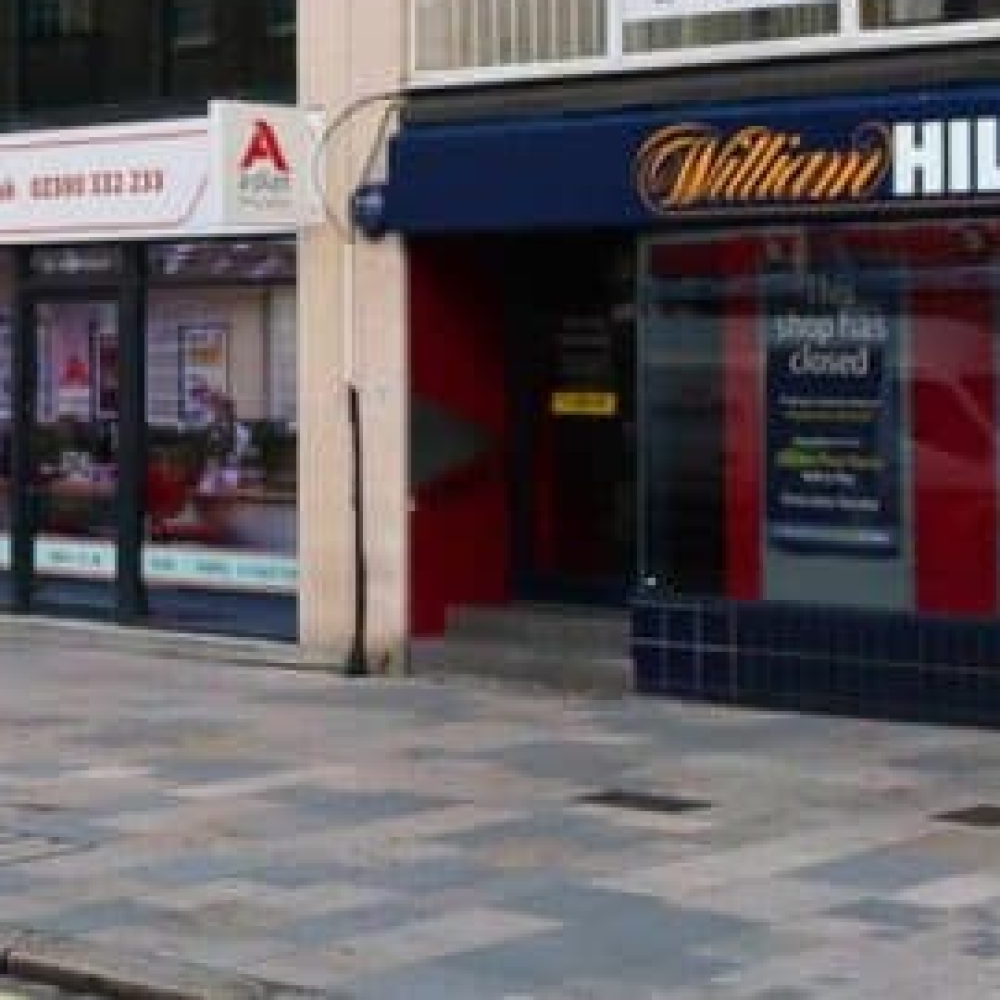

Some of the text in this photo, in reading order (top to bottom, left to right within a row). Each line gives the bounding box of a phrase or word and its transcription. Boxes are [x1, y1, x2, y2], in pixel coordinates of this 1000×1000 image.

[634, 115, 1000, 214] William HIL
[788, 343, 868, 376] closed
